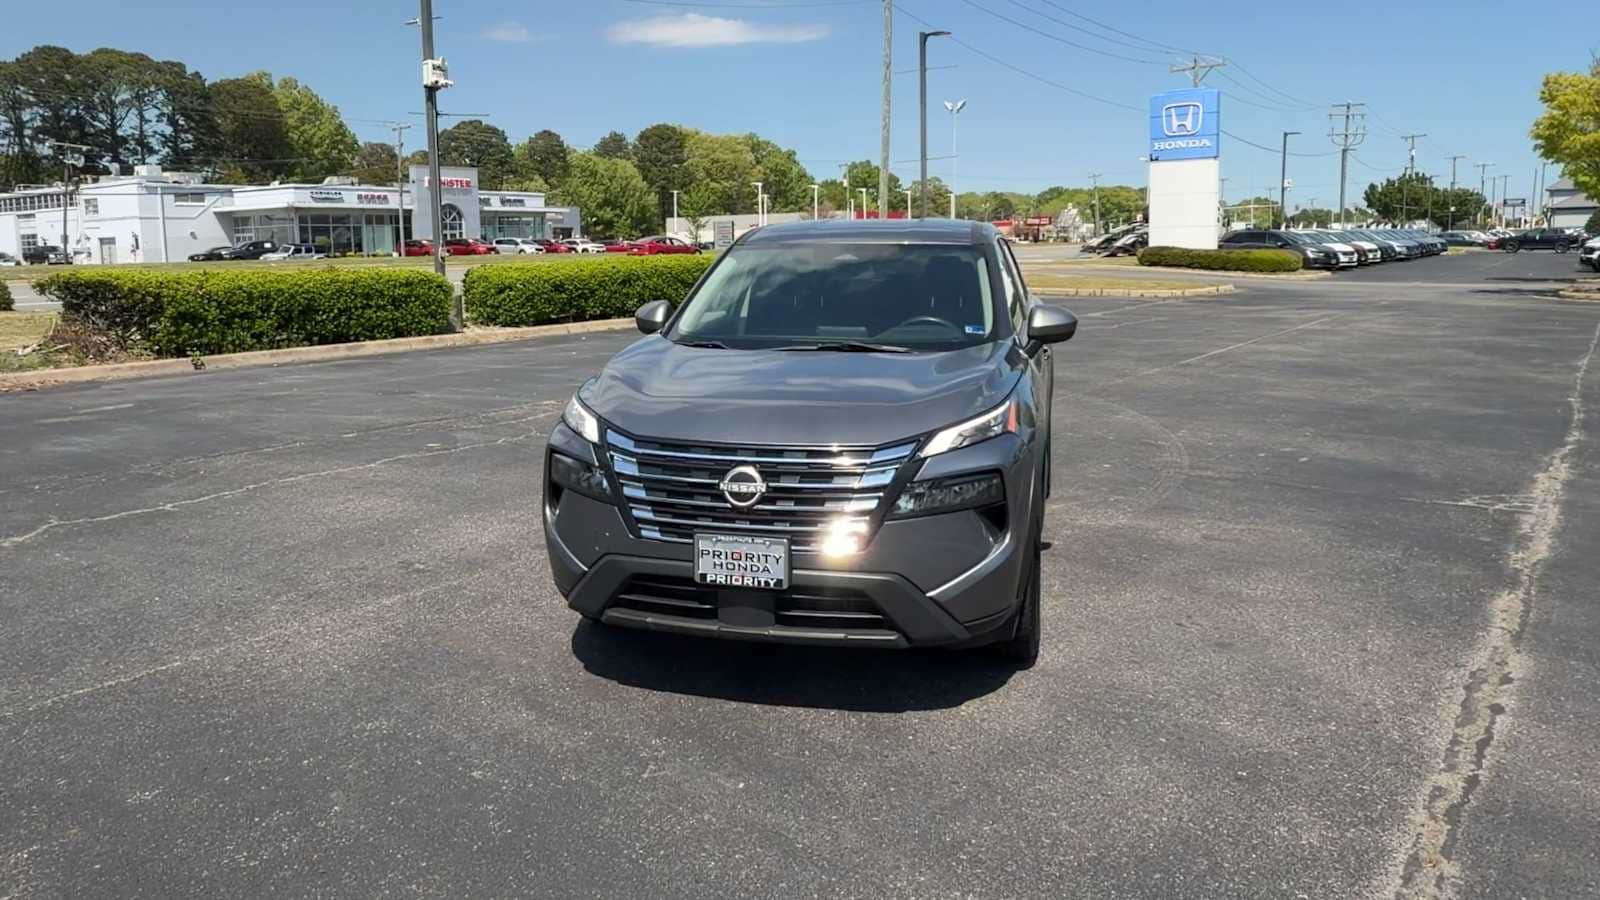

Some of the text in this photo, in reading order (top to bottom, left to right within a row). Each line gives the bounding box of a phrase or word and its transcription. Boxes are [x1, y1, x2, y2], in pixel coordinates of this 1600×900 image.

[1153, 139, 1212, 151] HONDA
[427, 177, 472, 188] NISTER
[720, 482, 767, 493] NISSAN
[700, 549, 783, 565] PRIORITY
[713, 561, 773, 574] HONDA
[706, 574, 777, 588] PRIORITY
